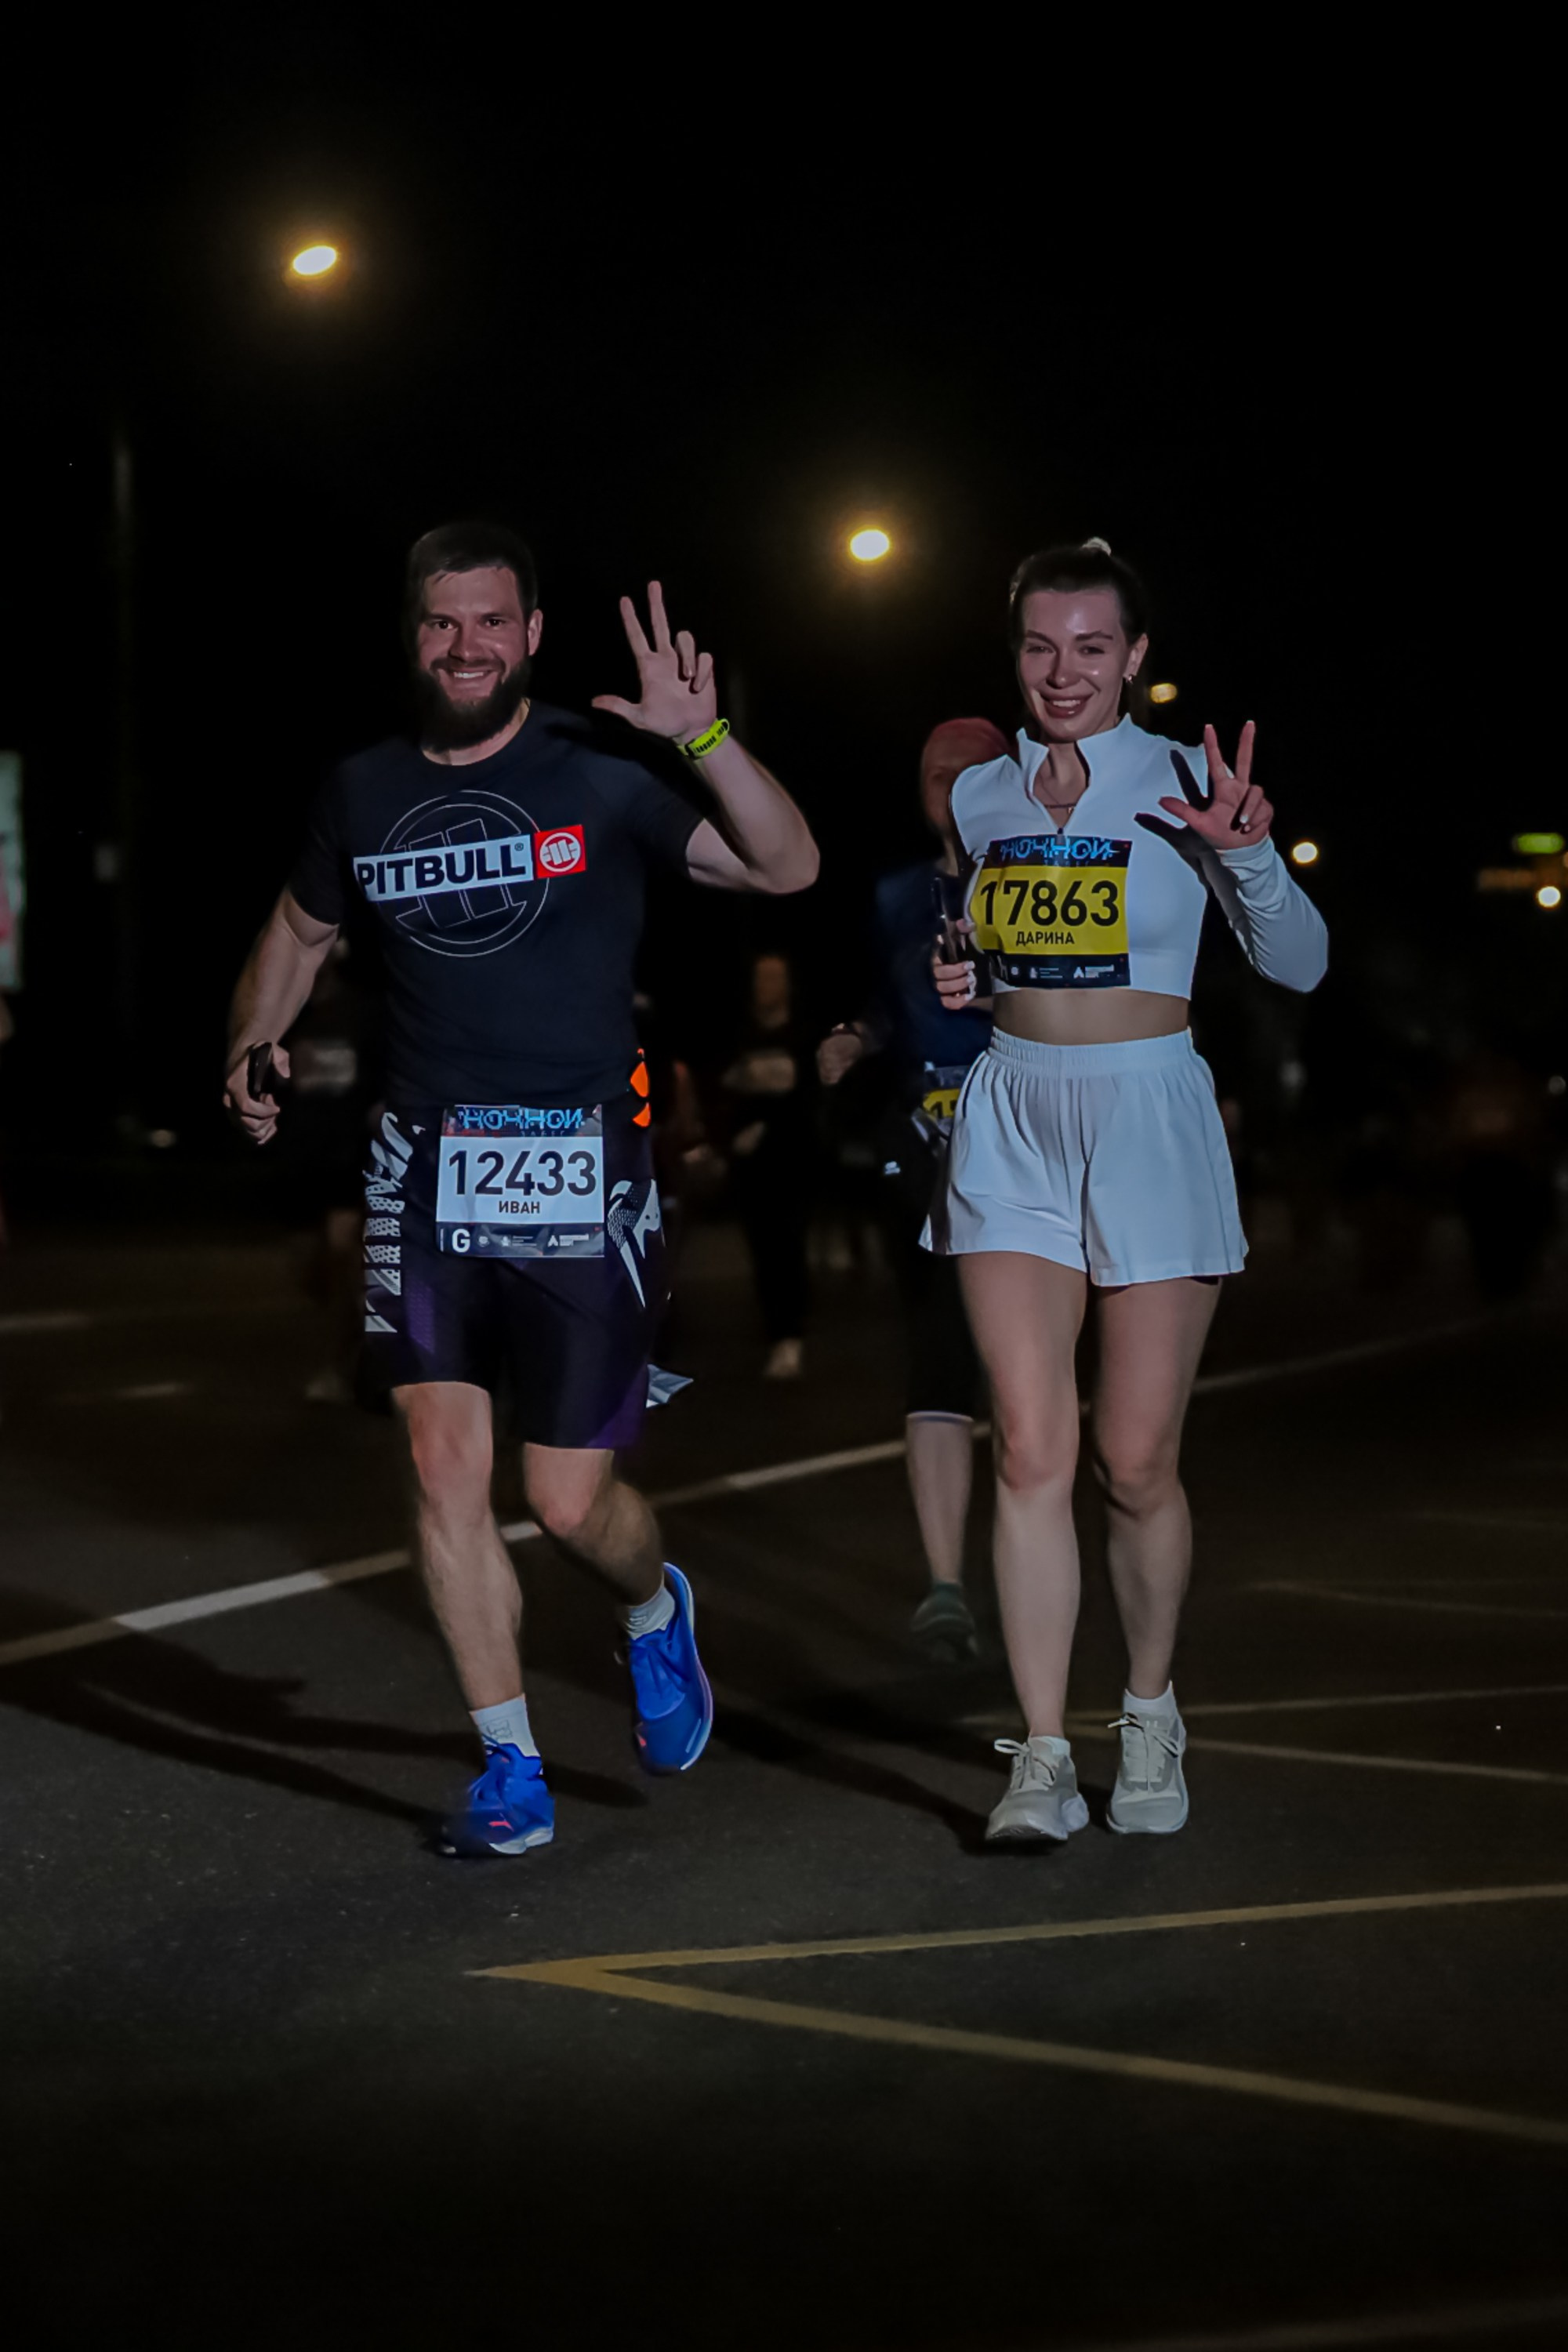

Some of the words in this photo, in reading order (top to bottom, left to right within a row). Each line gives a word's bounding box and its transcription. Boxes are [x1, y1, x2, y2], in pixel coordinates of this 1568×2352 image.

[357, 844, 526, 895] PITBULL
[980, 880, 1119, 927] 17863
[1016, 931, 1075, 946] ДАРИНА
[449, 1150, 596, 1196] 12433
[499, 1200, 540, 1214] ИВАН
[452, 1228, 470, 1253] G
